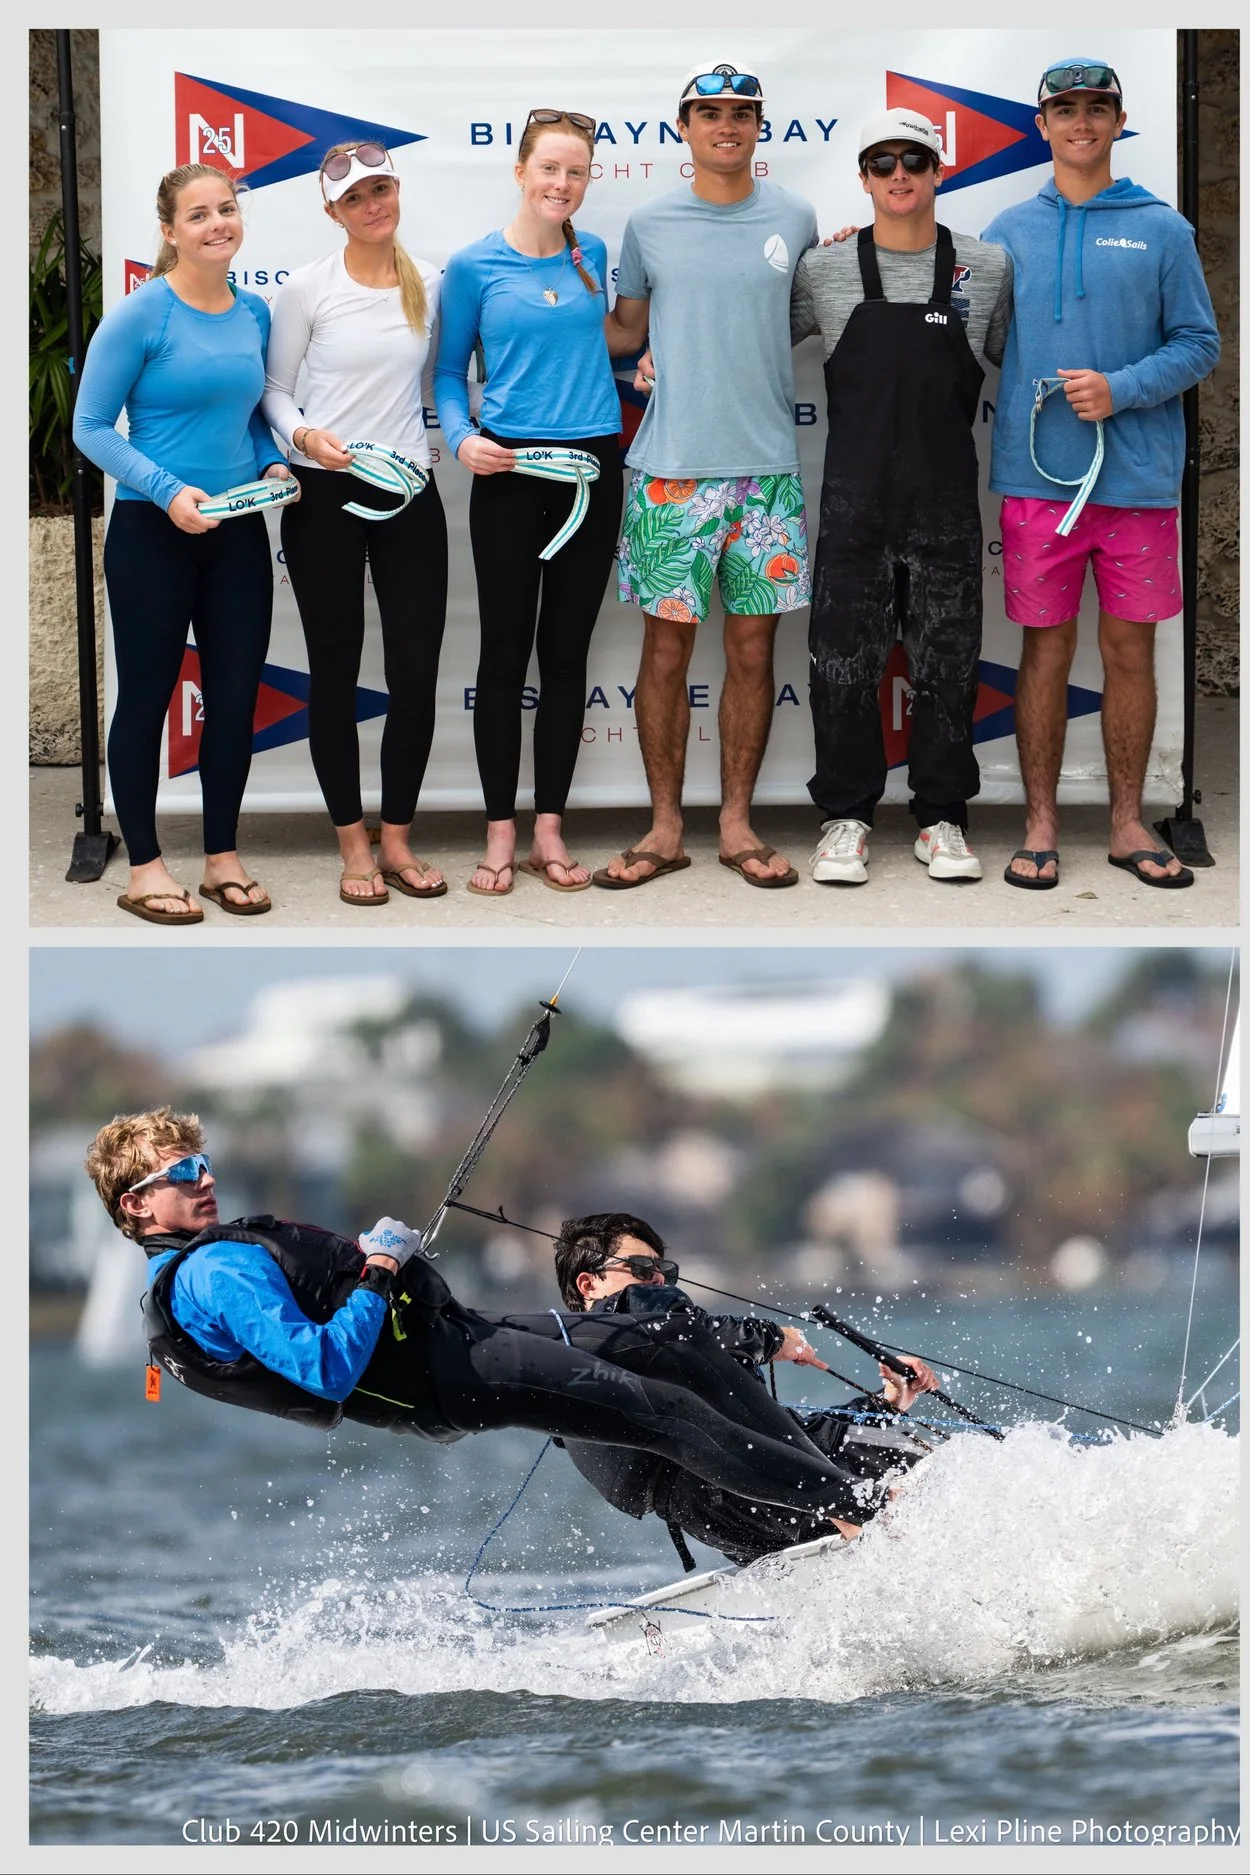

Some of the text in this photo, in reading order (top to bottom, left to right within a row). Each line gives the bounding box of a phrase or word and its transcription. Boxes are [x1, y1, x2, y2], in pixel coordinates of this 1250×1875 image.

[753, 118, 838, 143] BAY
[202, 127, 232, 154] 25
[924, 311, 948, 325] Gill
[390, 450, 406, 464] 3rd
[569, 451, 583, 461] 3rd
[270, 490, 284, 502] 3rd
